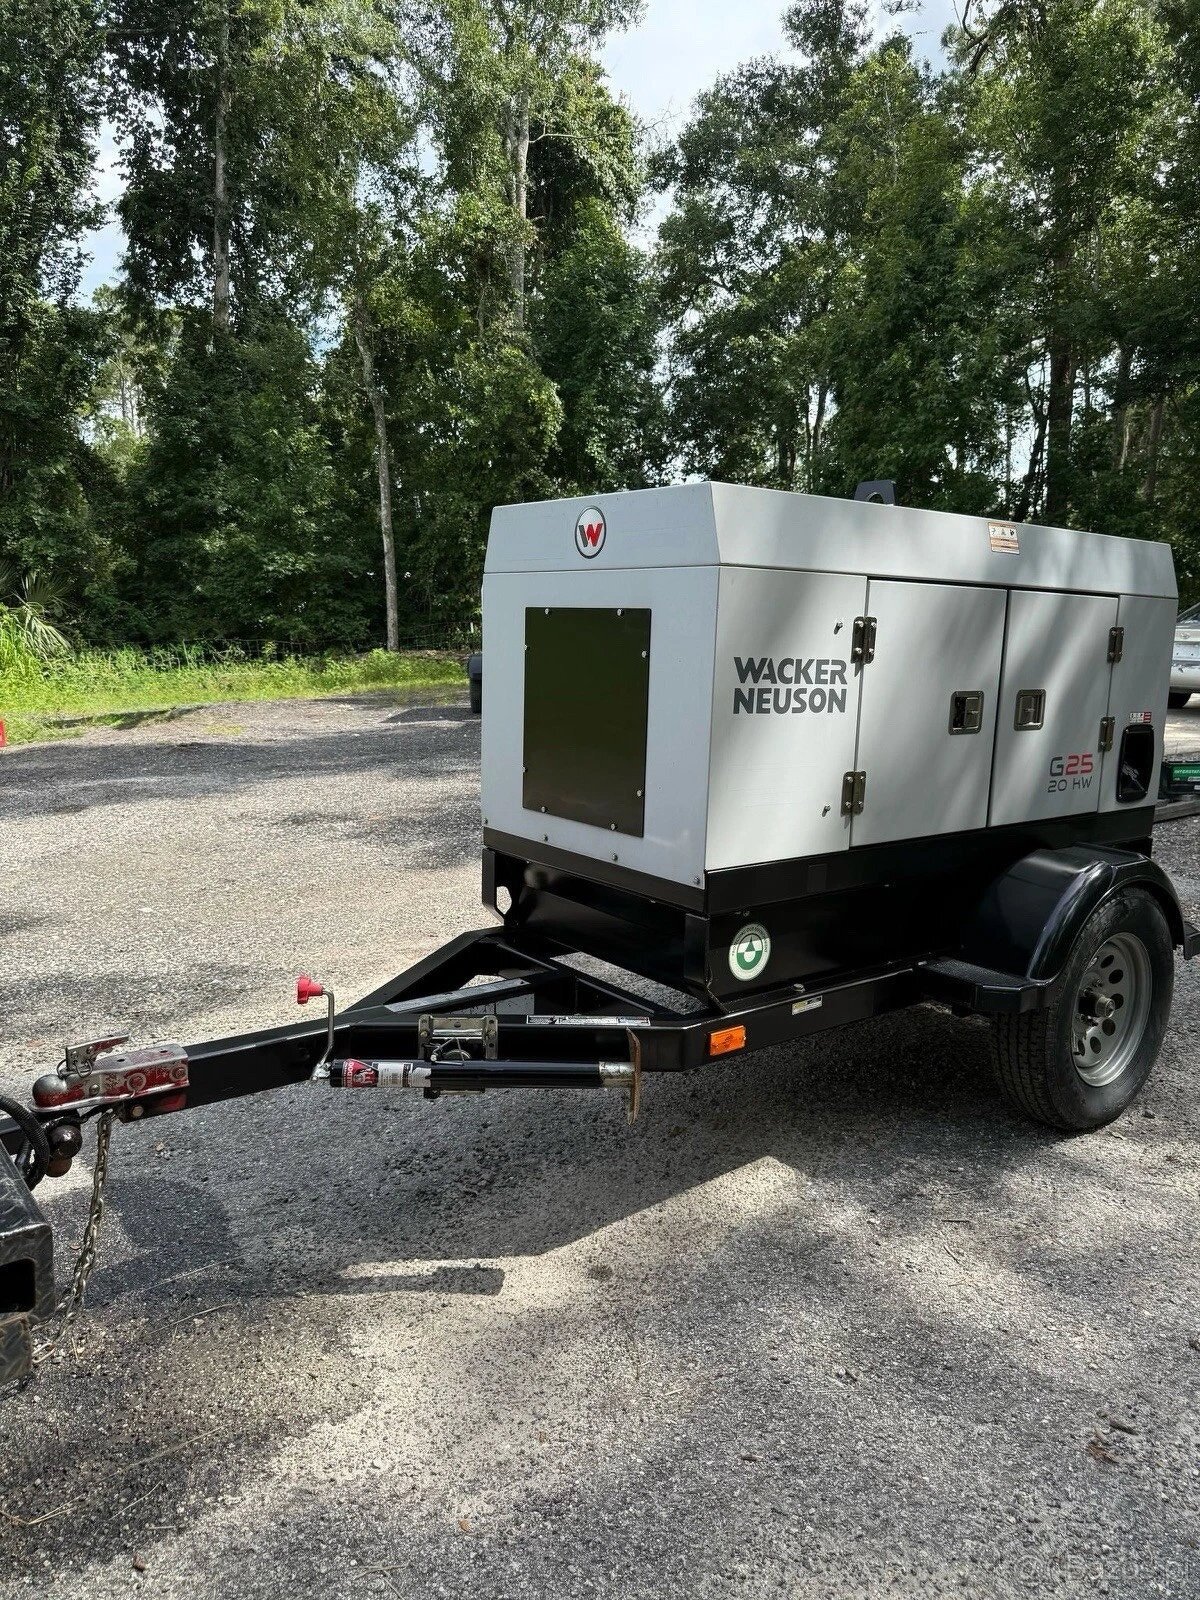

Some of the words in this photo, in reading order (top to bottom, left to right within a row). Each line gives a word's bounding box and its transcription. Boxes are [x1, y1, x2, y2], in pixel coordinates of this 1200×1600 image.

[733, 656, 848, 685] WACKER
[732, 687, 847, 715] NEUSON
[1050, 754, 1093, 776] G25
[1047, 779, 1068, 793] 20
